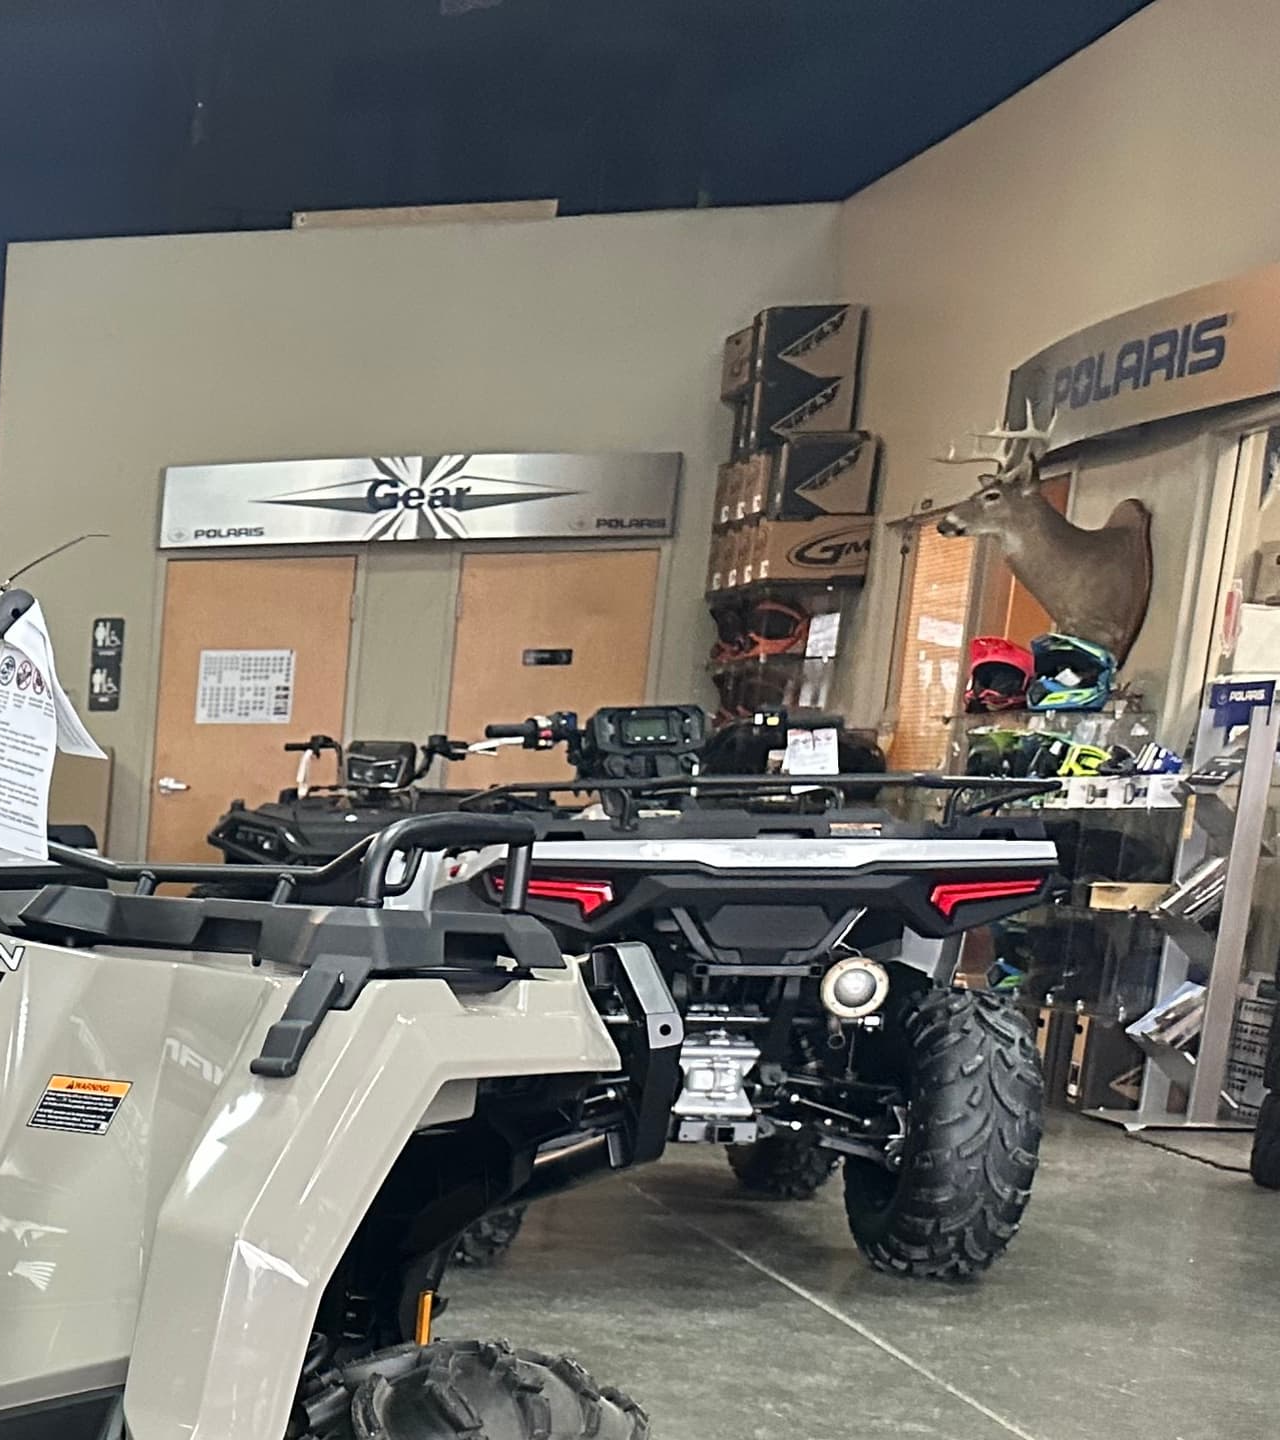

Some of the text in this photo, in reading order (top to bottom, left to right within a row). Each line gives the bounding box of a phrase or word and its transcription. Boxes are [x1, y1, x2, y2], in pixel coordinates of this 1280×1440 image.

[1054, 313, 1228, 410] POLARIS
[366, 477, 472, 513] Gear
[595, 516, 667, 530] POLARIS
[193, 526, 265, 541] POLARIS
[1228, 688, 1266, 702] POLARIS
[74, 1081, 111, 1093] WARNING
